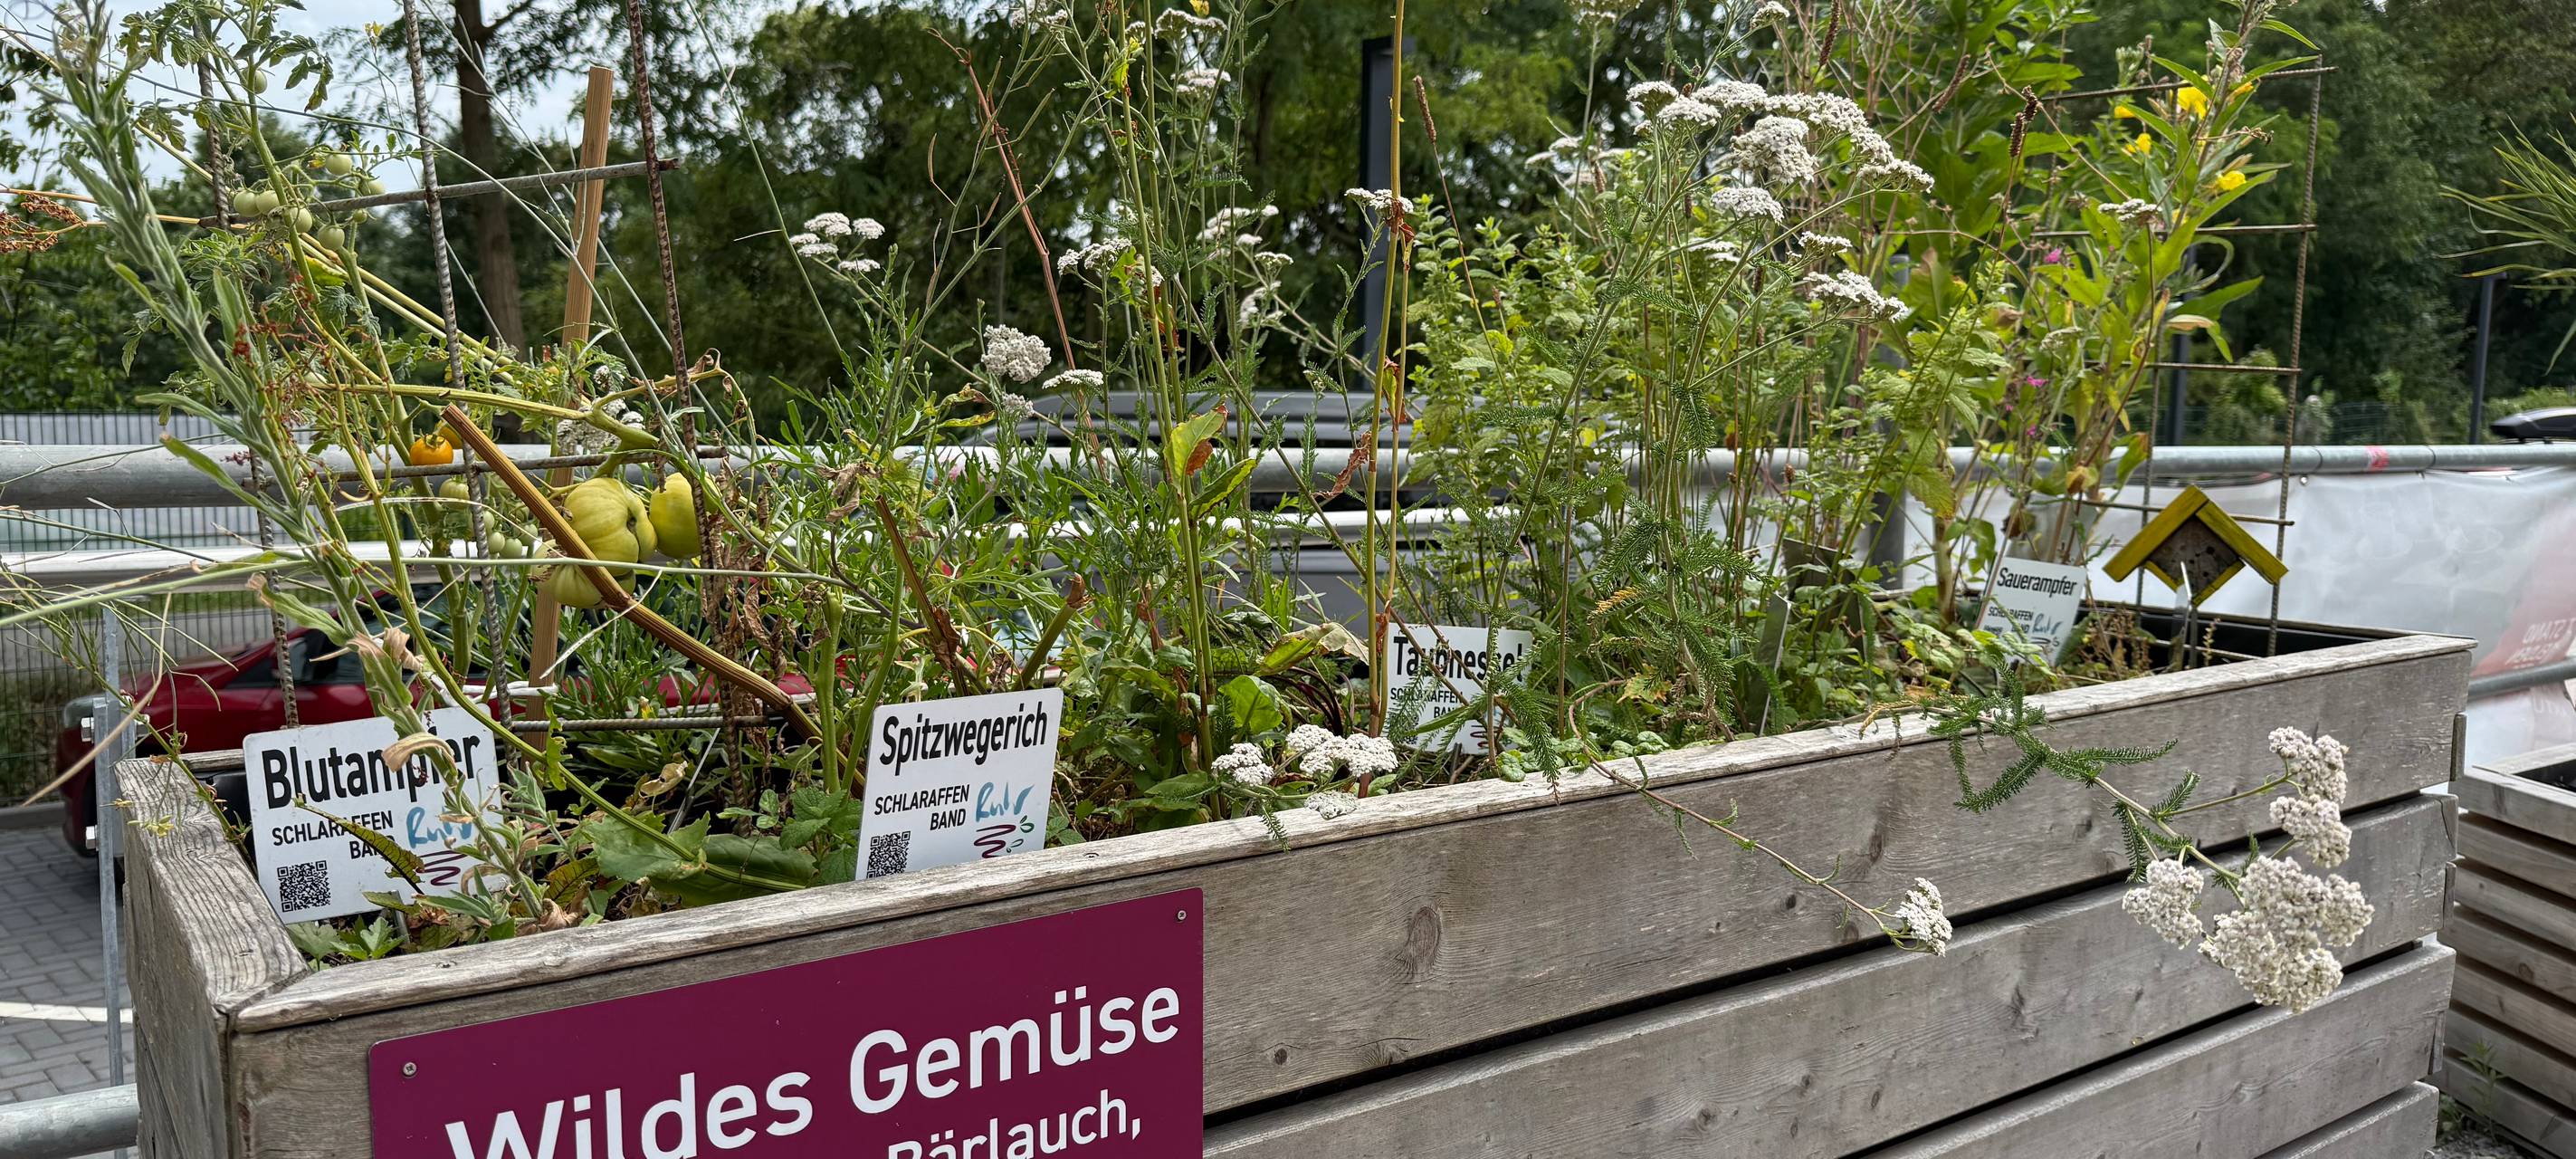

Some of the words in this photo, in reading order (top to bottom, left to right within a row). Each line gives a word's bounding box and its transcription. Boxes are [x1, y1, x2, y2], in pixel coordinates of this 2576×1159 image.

[1997, 566, 2077, 598] Sauerampfer
[1988, 606, 2034, 621] SCHRAFFEN
[1390, 687, 1464, 704] SCAFFE
[879, 701, 1047, 776] Spitzwegerich
[874, 784, 970, 816] SCHLARAFFEN
[930, 808, 967, 831] BAND
[348, 835, 396, 860] BA
[849, 985, 1179, 1115] Gemüse
